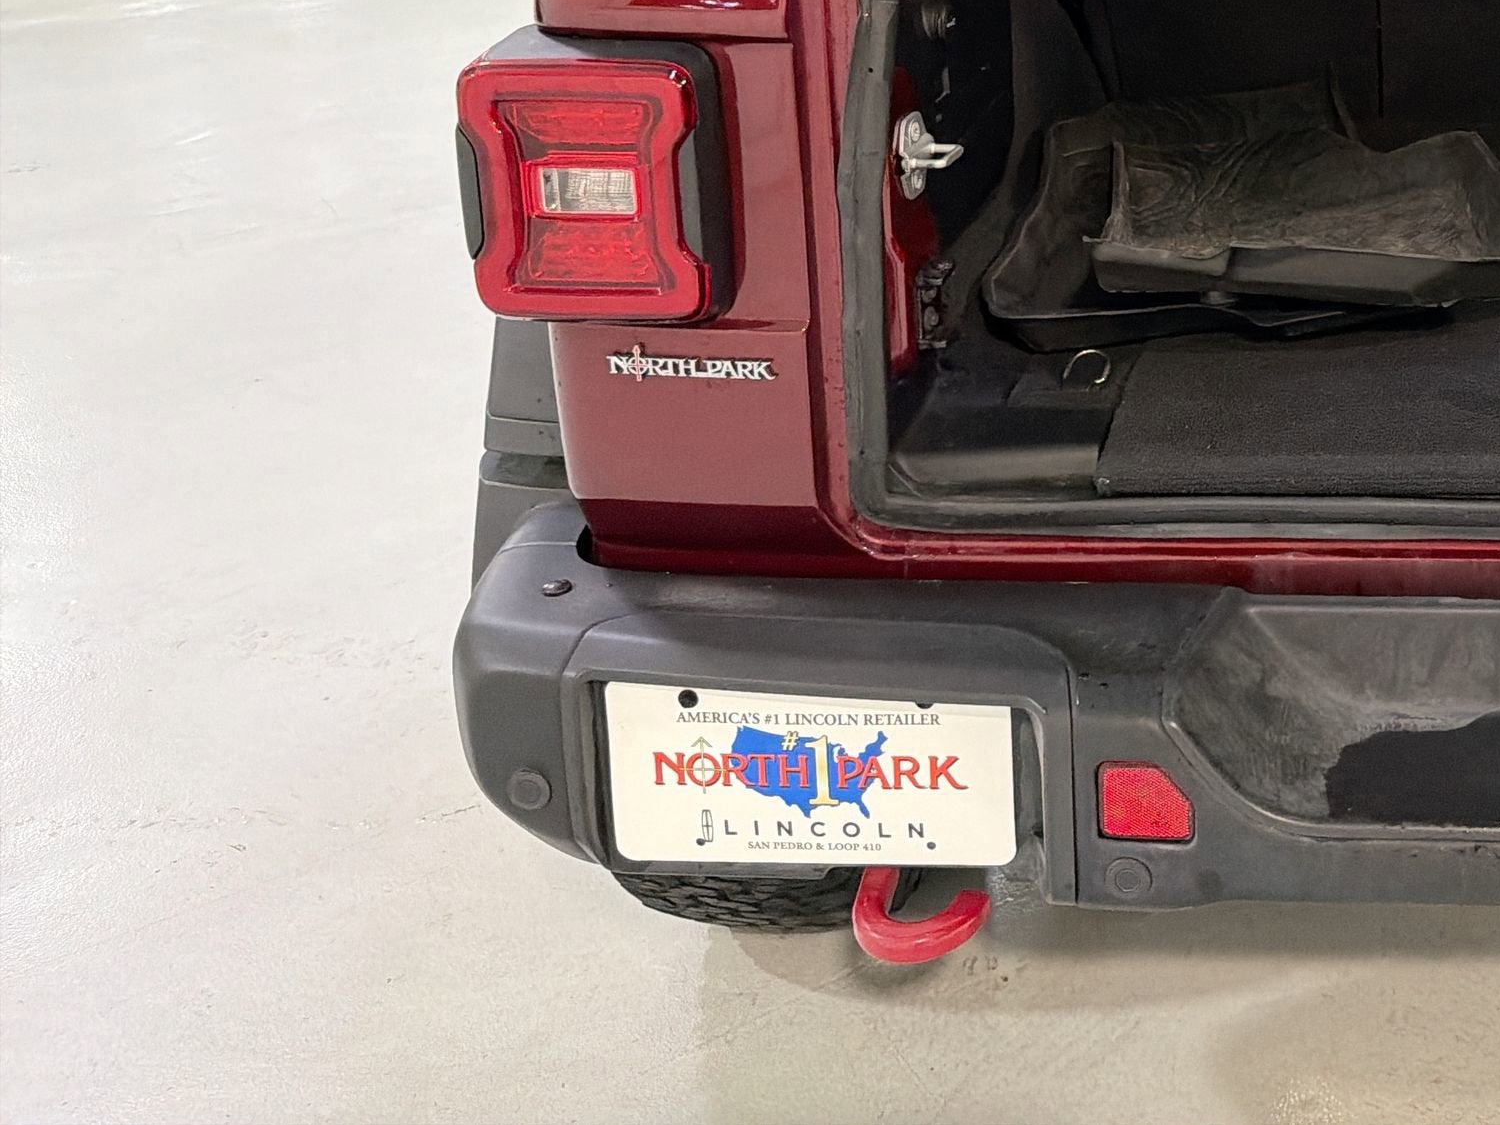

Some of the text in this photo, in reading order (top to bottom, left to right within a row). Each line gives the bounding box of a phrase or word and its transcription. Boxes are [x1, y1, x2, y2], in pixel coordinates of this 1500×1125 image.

[606, 354, 776, 381] NORTH PARK
[676, 711, 940, 726] AMERICA'S #1 LINCOLN RETAILER
[653, 750, 969, 791] NORTH PARK
[723, 819, 926, 838] LINCOLN
[747, 840, 882, 851] SAN PEDRO & LOOP 410
